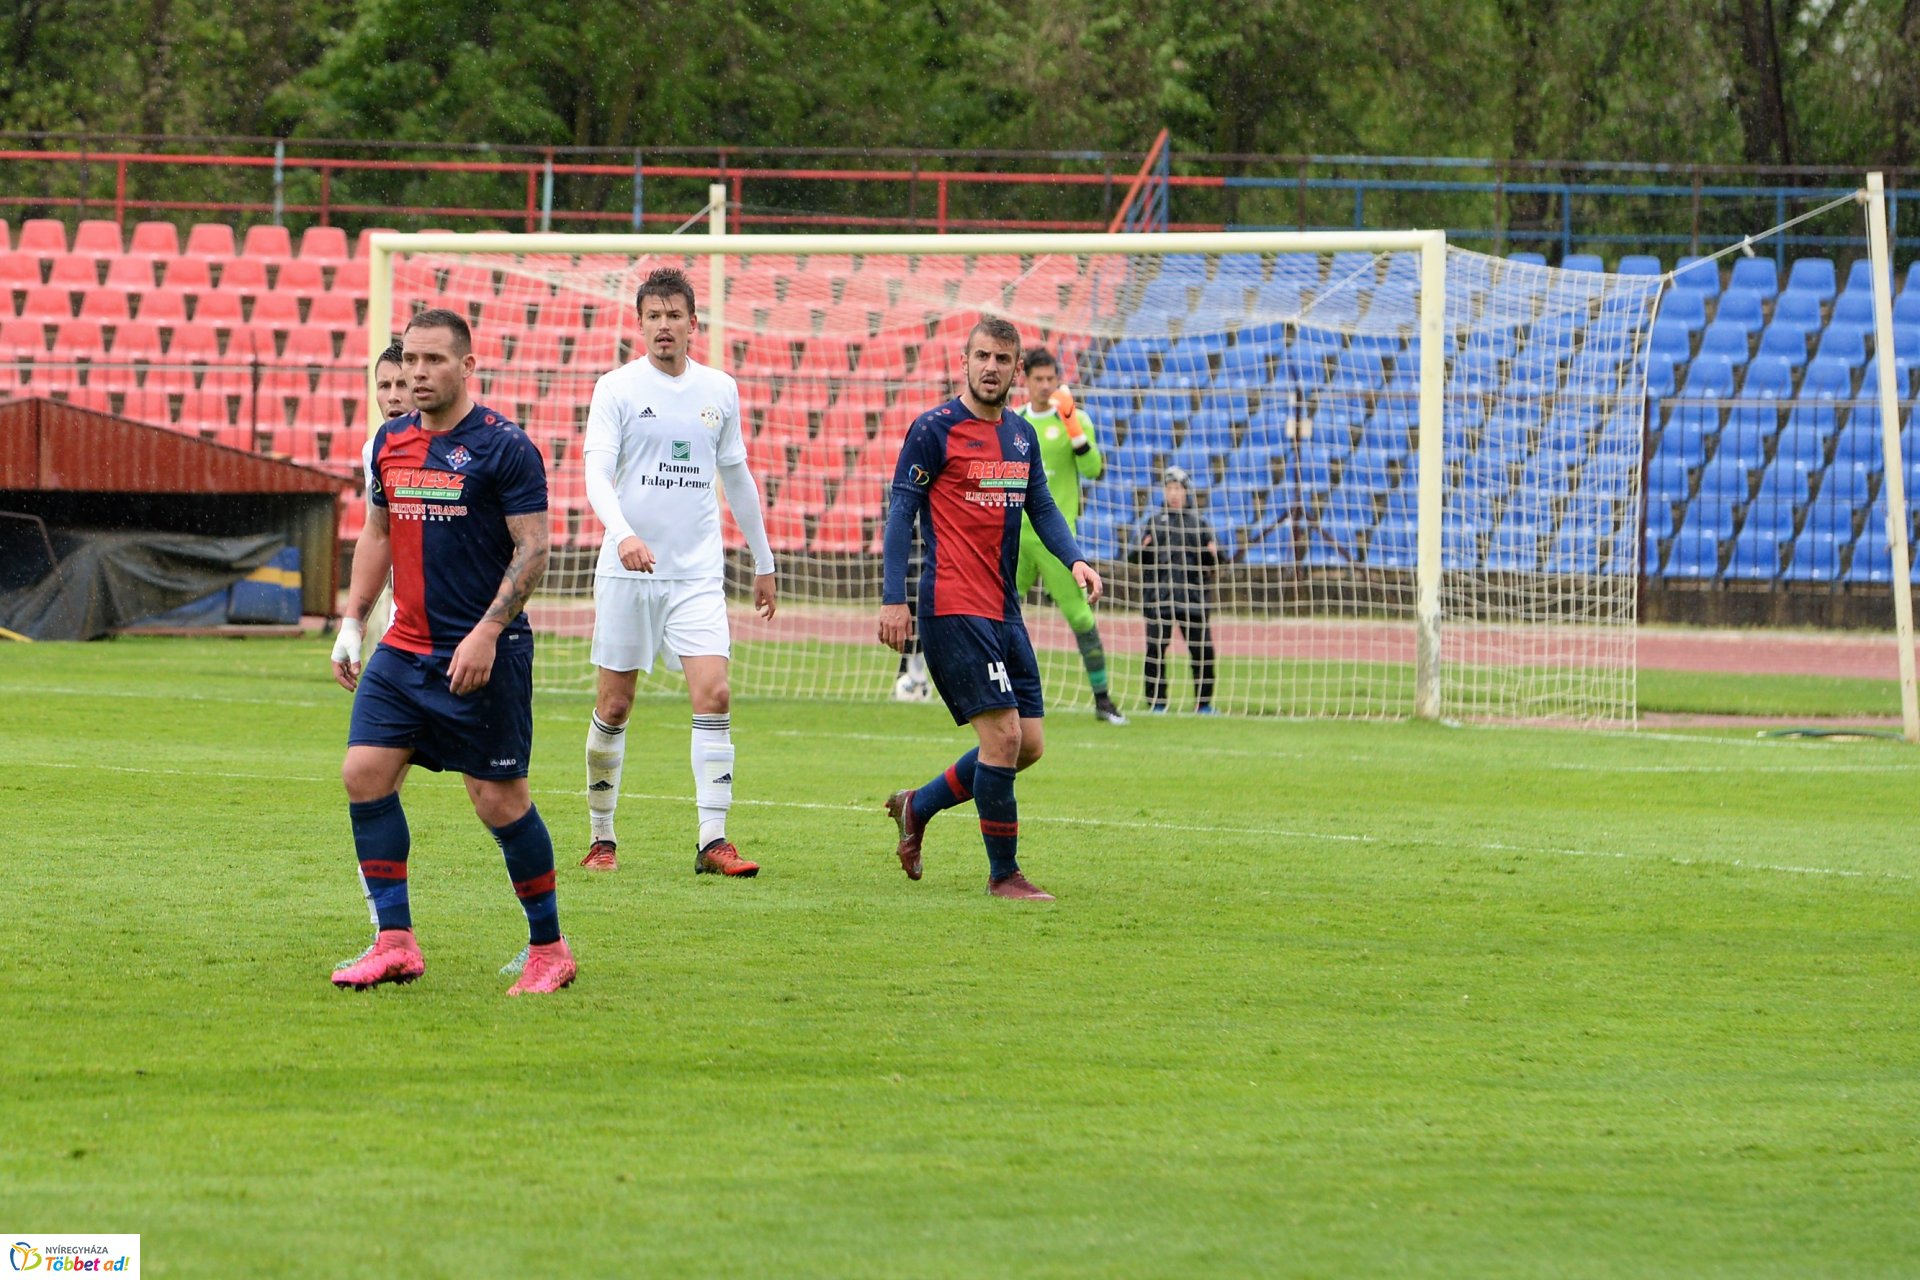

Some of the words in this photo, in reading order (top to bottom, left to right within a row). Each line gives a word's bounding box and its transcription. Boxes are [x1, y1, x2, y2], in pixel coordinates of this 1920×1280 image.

[658, 462, 700, 474] Pannon
[427, 504, 468, 517] TRANS
[398, 513, 452, 521] HUNGARY
[499, 758, 517, 767] JAKO
